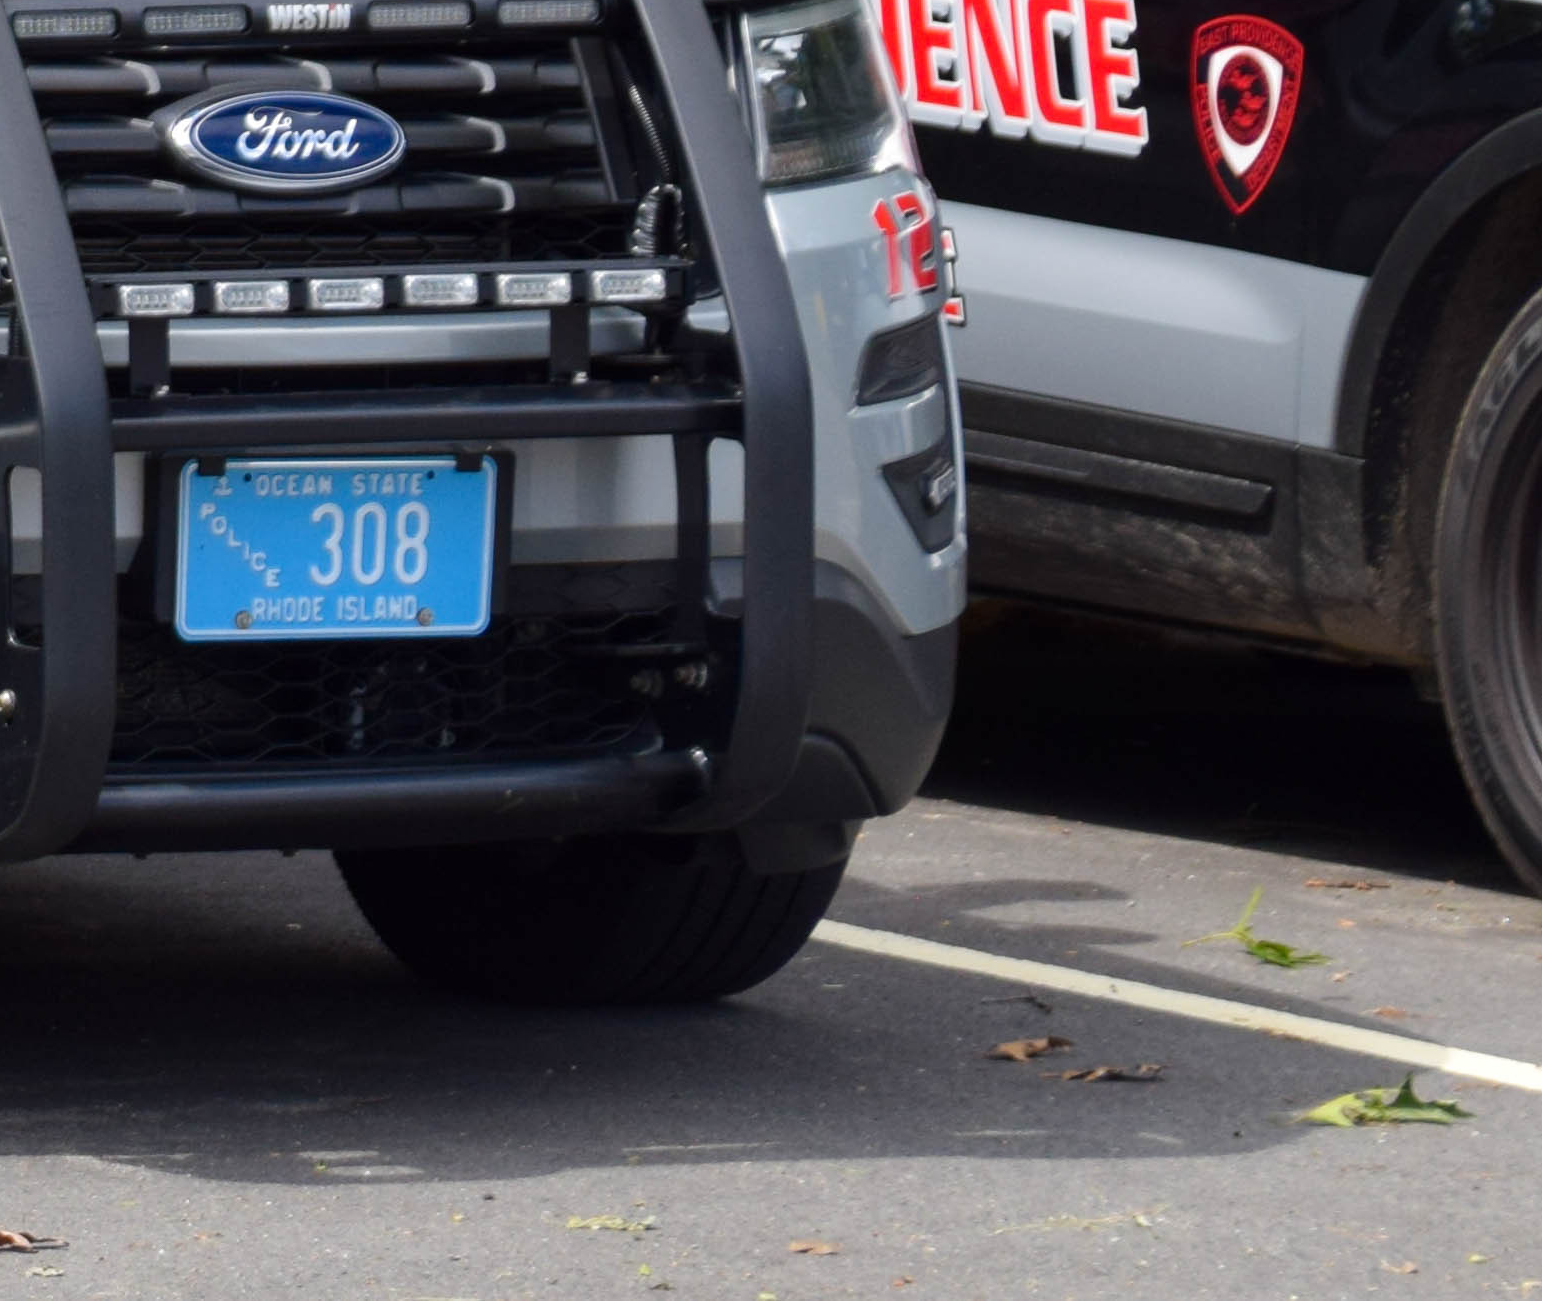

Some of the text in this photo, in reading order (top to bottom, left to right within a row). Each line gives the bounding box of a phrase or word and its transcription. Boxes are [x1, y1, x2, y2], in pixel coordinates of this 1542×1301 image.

[235, 106, 361, 161] Ford
[872, 190, 939, 301] 12
[254, 472, 424, 497] OCEAN STATE
[199, 502, 282, 588] POLICE
[309, 501, 430, 586] 308
[250, 594, 418, 623] RHODE ISLAND
